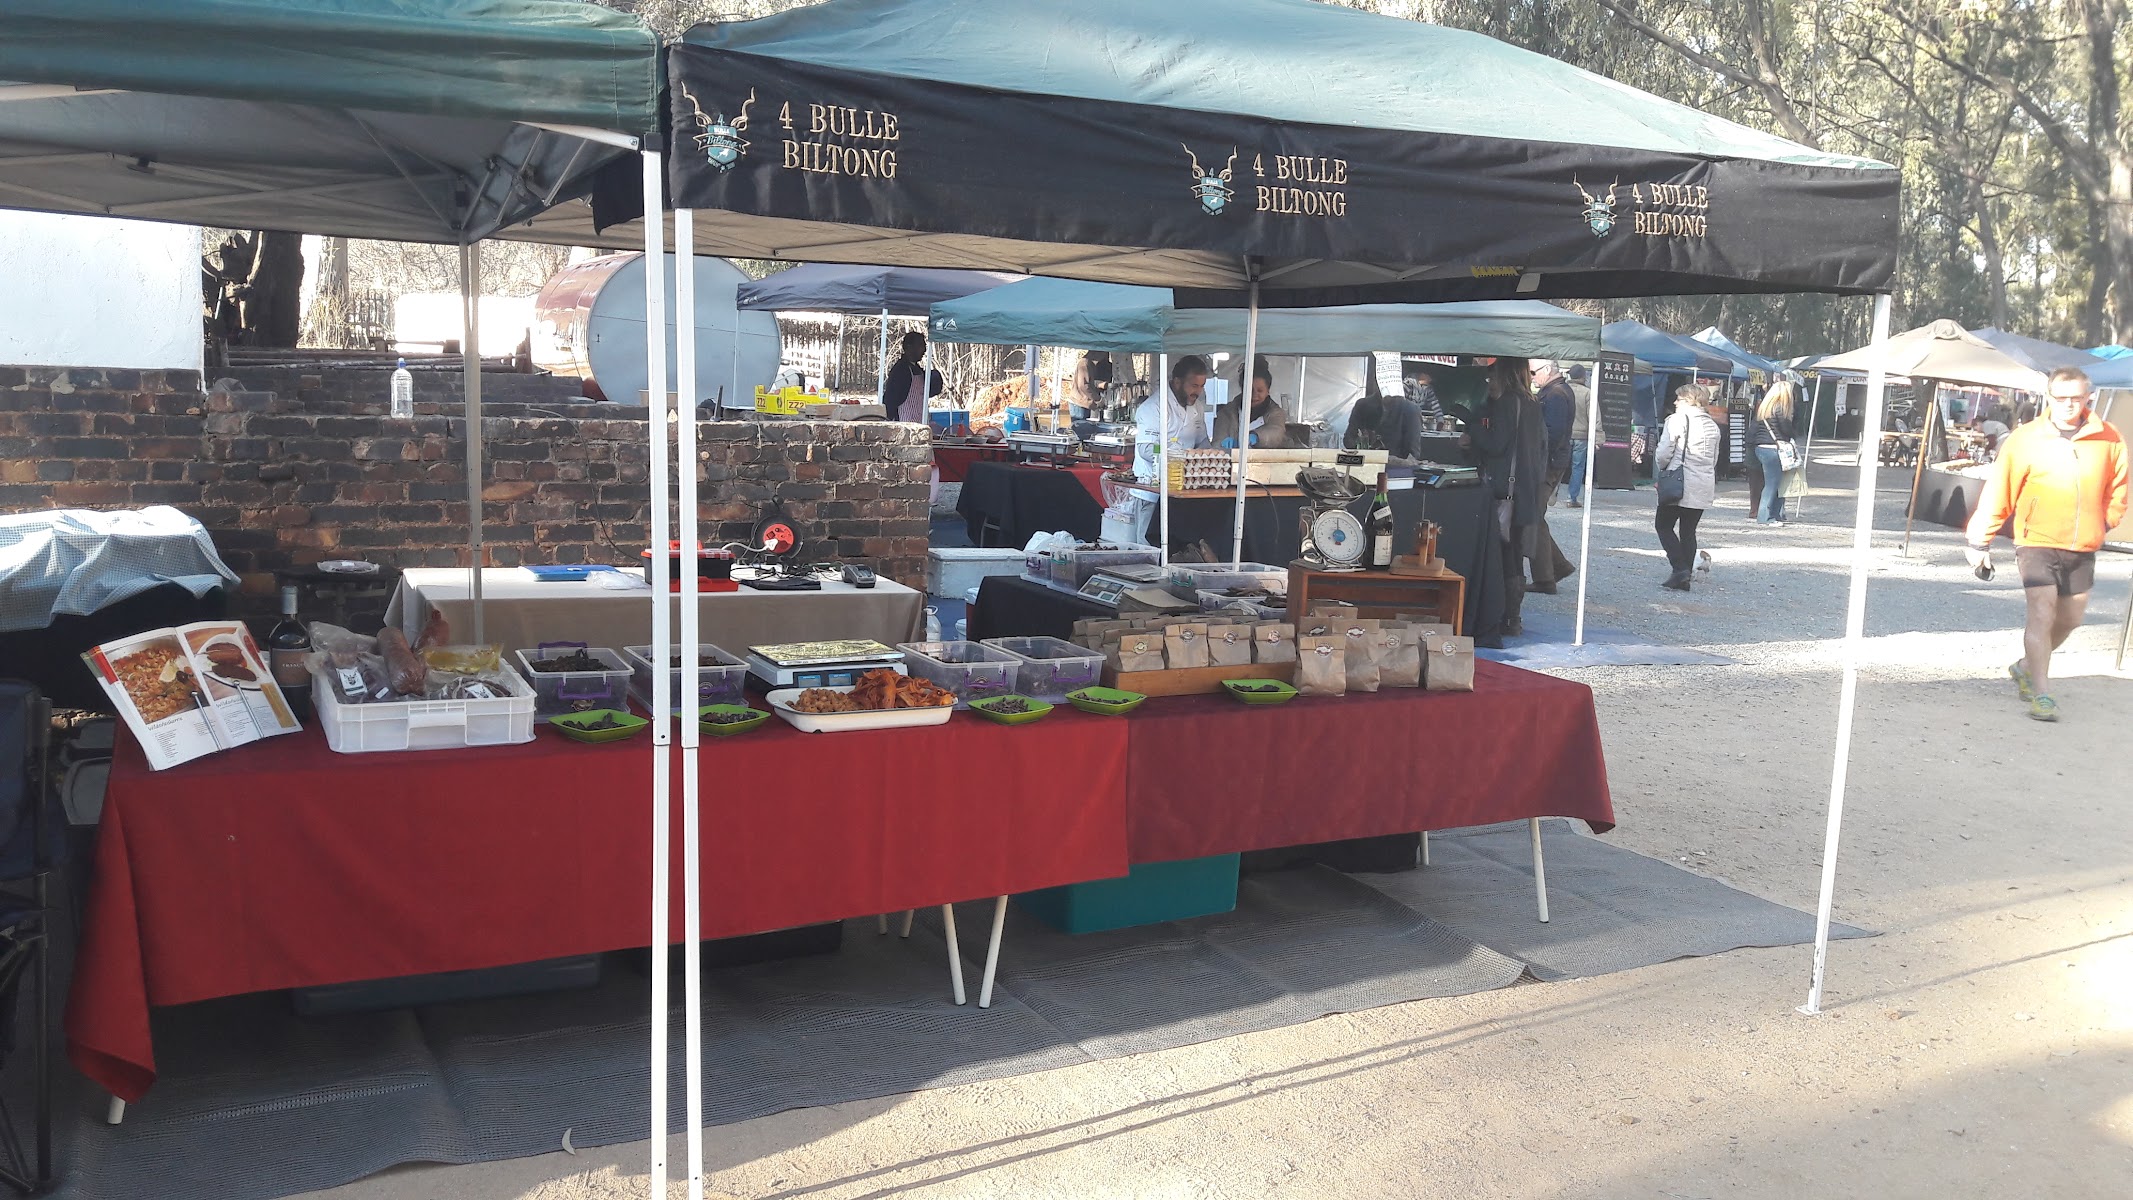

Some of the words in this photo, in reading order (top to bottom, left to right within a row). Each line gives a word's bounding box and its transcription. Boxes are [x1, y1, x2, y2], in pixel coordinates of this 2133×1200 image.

[779, 101, 793, 129] 4
[809, 104, 900, 140] BULLE
[782, 140, 898, 179] BILTONG
[1253, 153, 1265, 177] 4
[1275, 155, 1348, 185] BULLE
[1256, 186, 1347, 217] BILTONG
[1632, 183, 1643, 204] 4
[1650, 183, 1708, 208] BULLE
[1634, 212, 1708, 237] BILTONG
